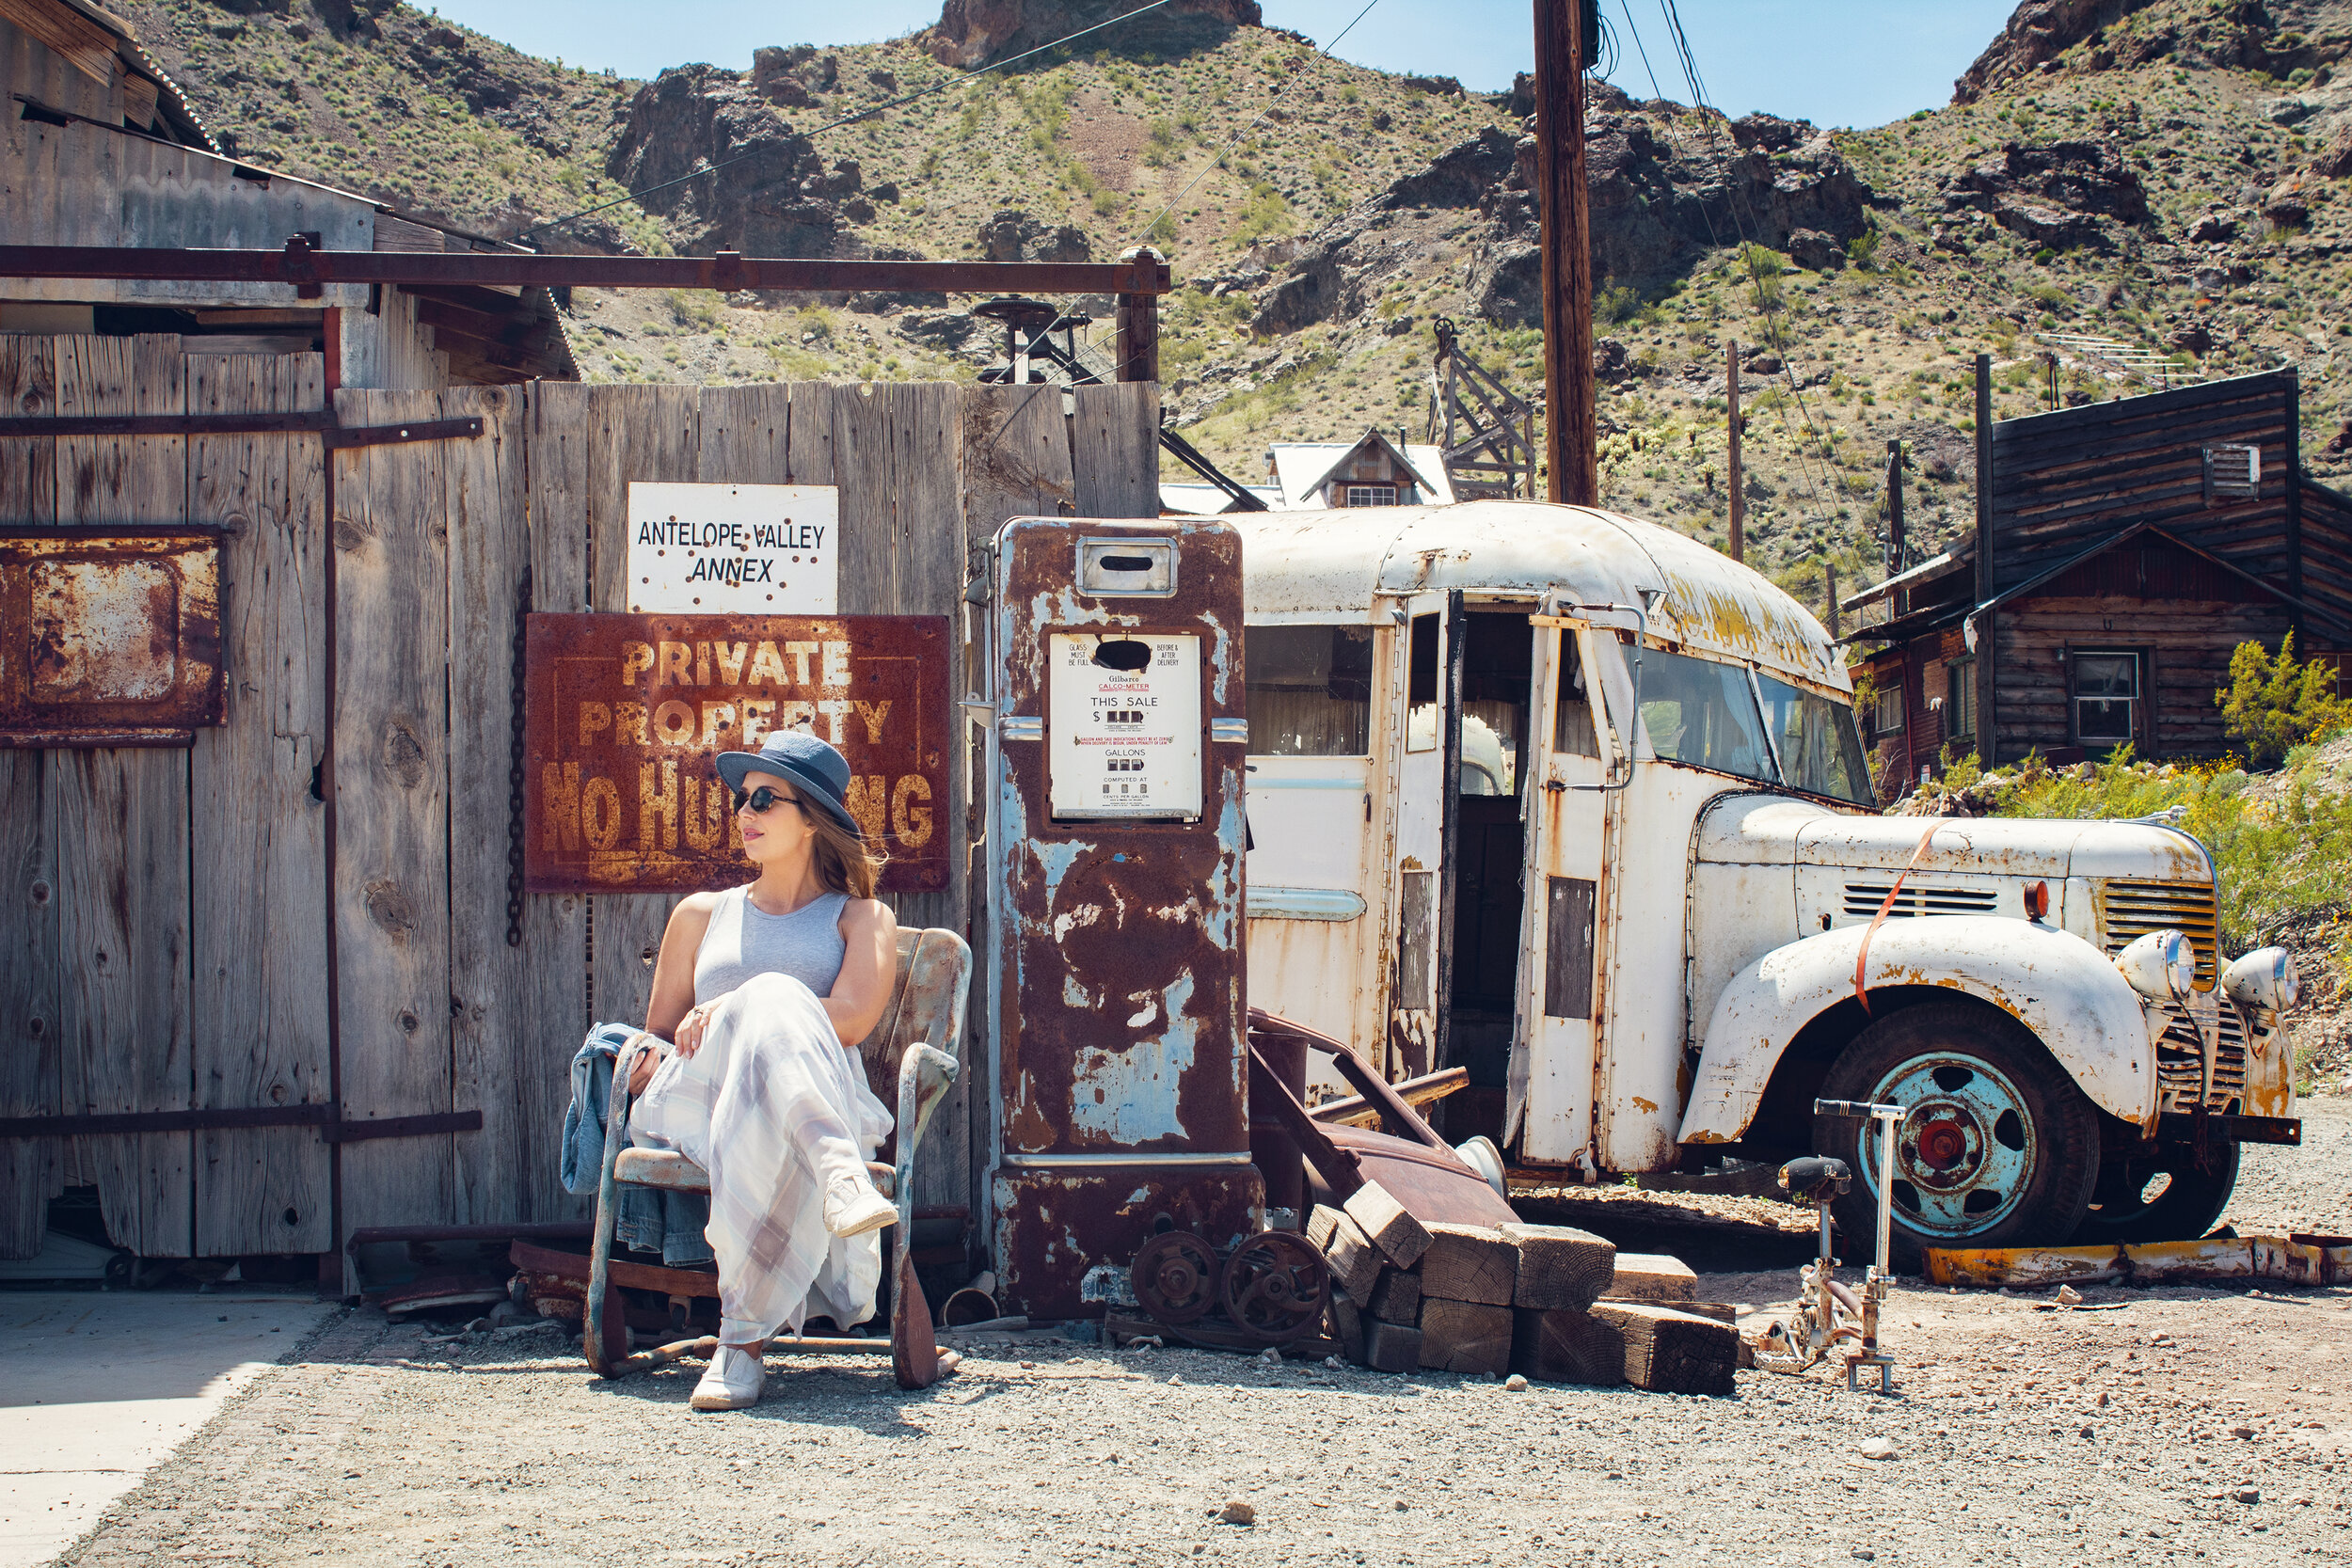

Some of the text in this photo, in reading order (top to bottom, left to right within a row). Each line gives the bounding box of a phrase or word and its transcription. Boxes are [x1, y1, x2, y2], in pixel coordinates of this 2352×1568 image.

[638, 521, 824, 549] ANTELOPE VALLEY
[691, 557, 774, 583] ANNEX
[622, 641, 852, 686] PRIVATE
[1090, 697, 1158, 706] THIS SALE
[579, 700, 893, 745] PROPERTY
[1092, 710, 1101, 722] $
[640, 761, 932, 849] HUNG
